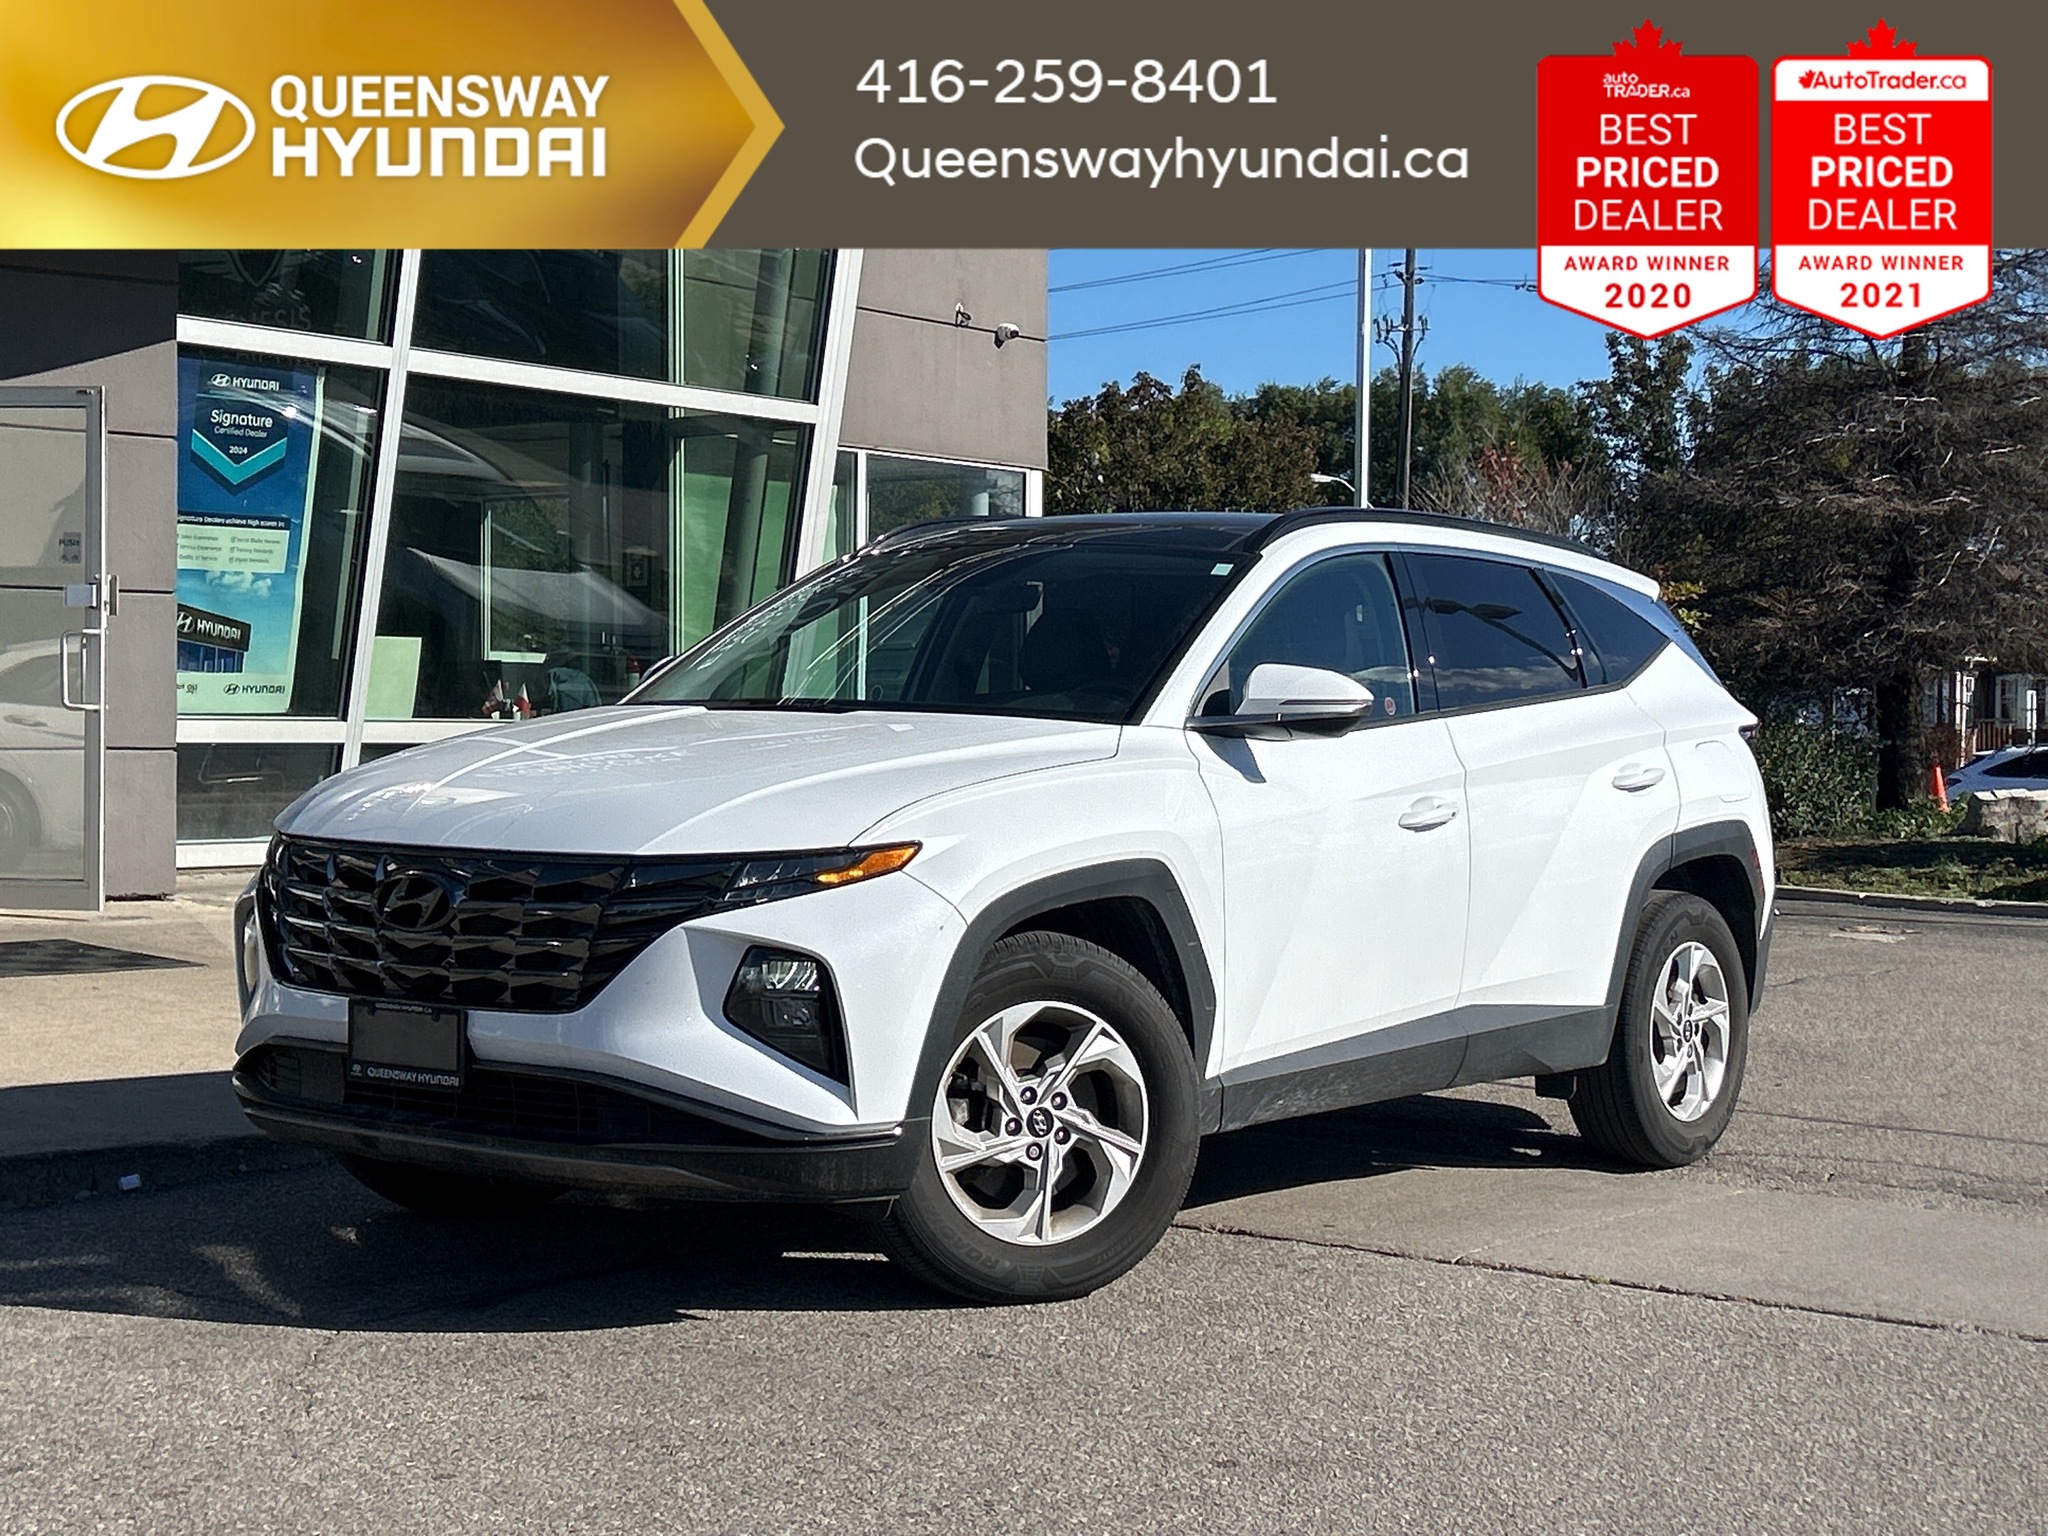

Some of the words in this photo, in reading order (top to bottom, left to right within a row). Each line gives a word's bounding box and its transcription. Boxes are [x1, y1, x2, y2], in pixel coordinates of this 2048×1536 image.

[232, 377, 280, 391] HYUNDAI
[210, 409, 273, 428] Signature
[214, 426, 244, 436] Certified
[245, 428, 268, 438] Dealer
[177, 514, 203, 523] ignature
[196, 618, 241, 641] HYUNDAI
[241, 685, 286, 695] HYUNDAI
[367, 1066, 417, 1083] QUEENSWAY
[417, 1072, 460, 1087] HYUNDAI
